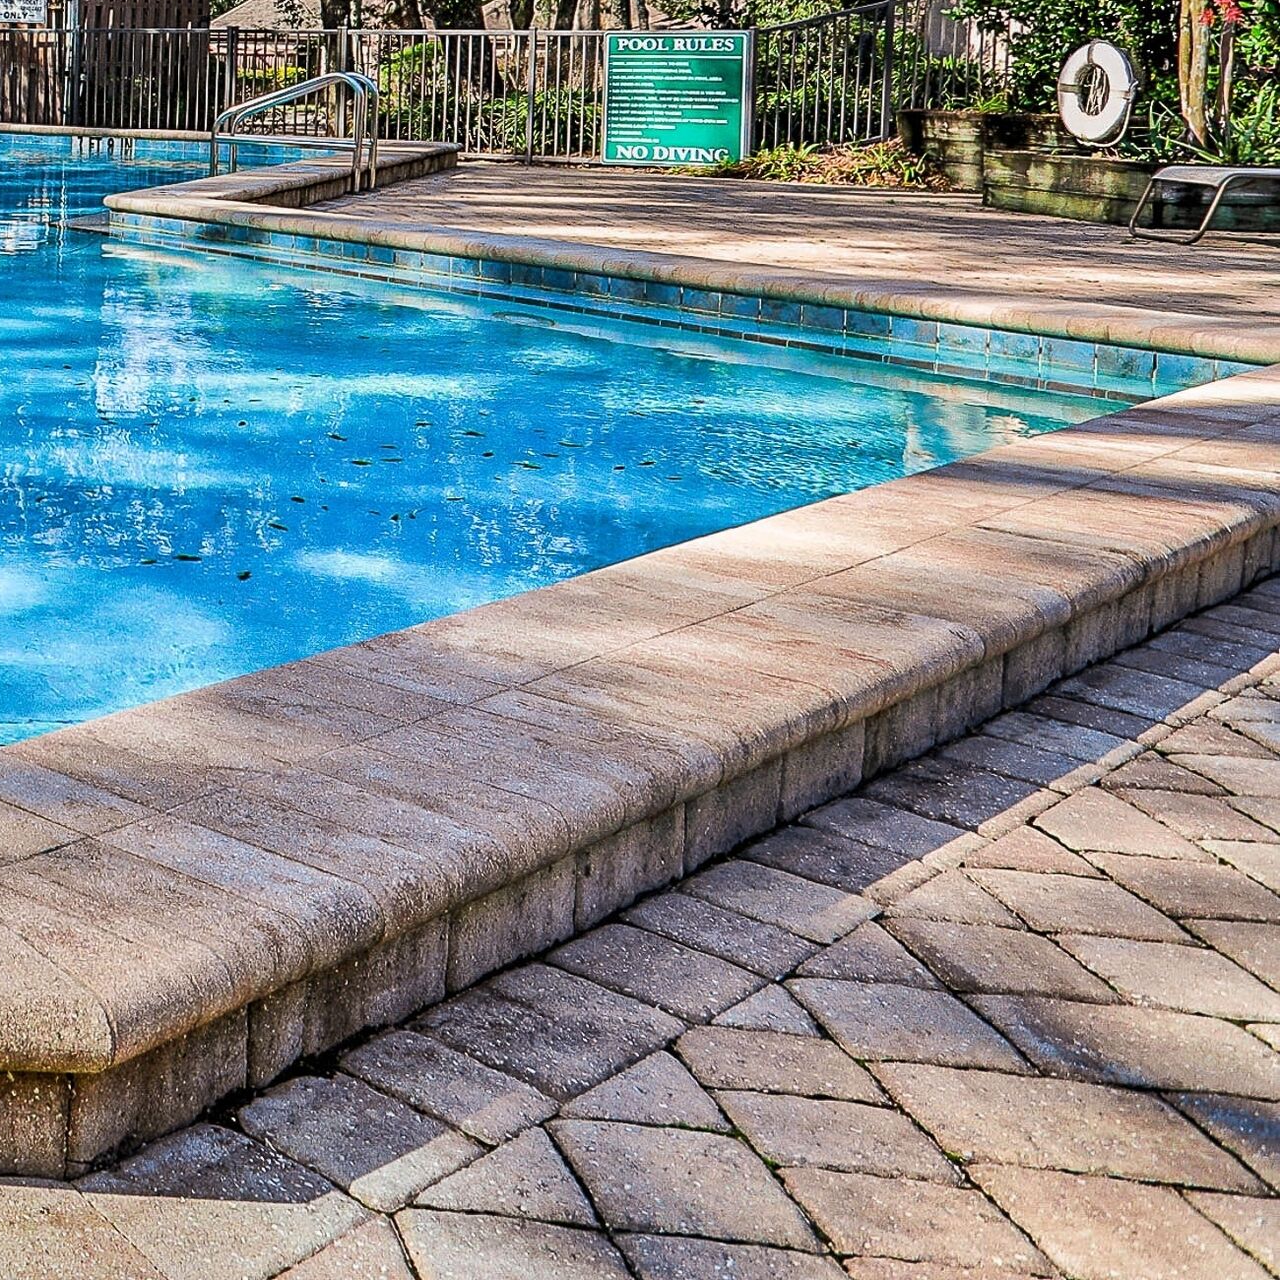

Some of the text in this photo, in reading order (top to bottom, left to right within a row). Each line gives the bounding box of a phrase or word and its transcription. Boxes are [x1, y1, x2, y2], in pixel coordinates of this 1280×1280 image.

[617, 38, 735, 52] POOL RULES
[615, 144, 649, 160] NO
